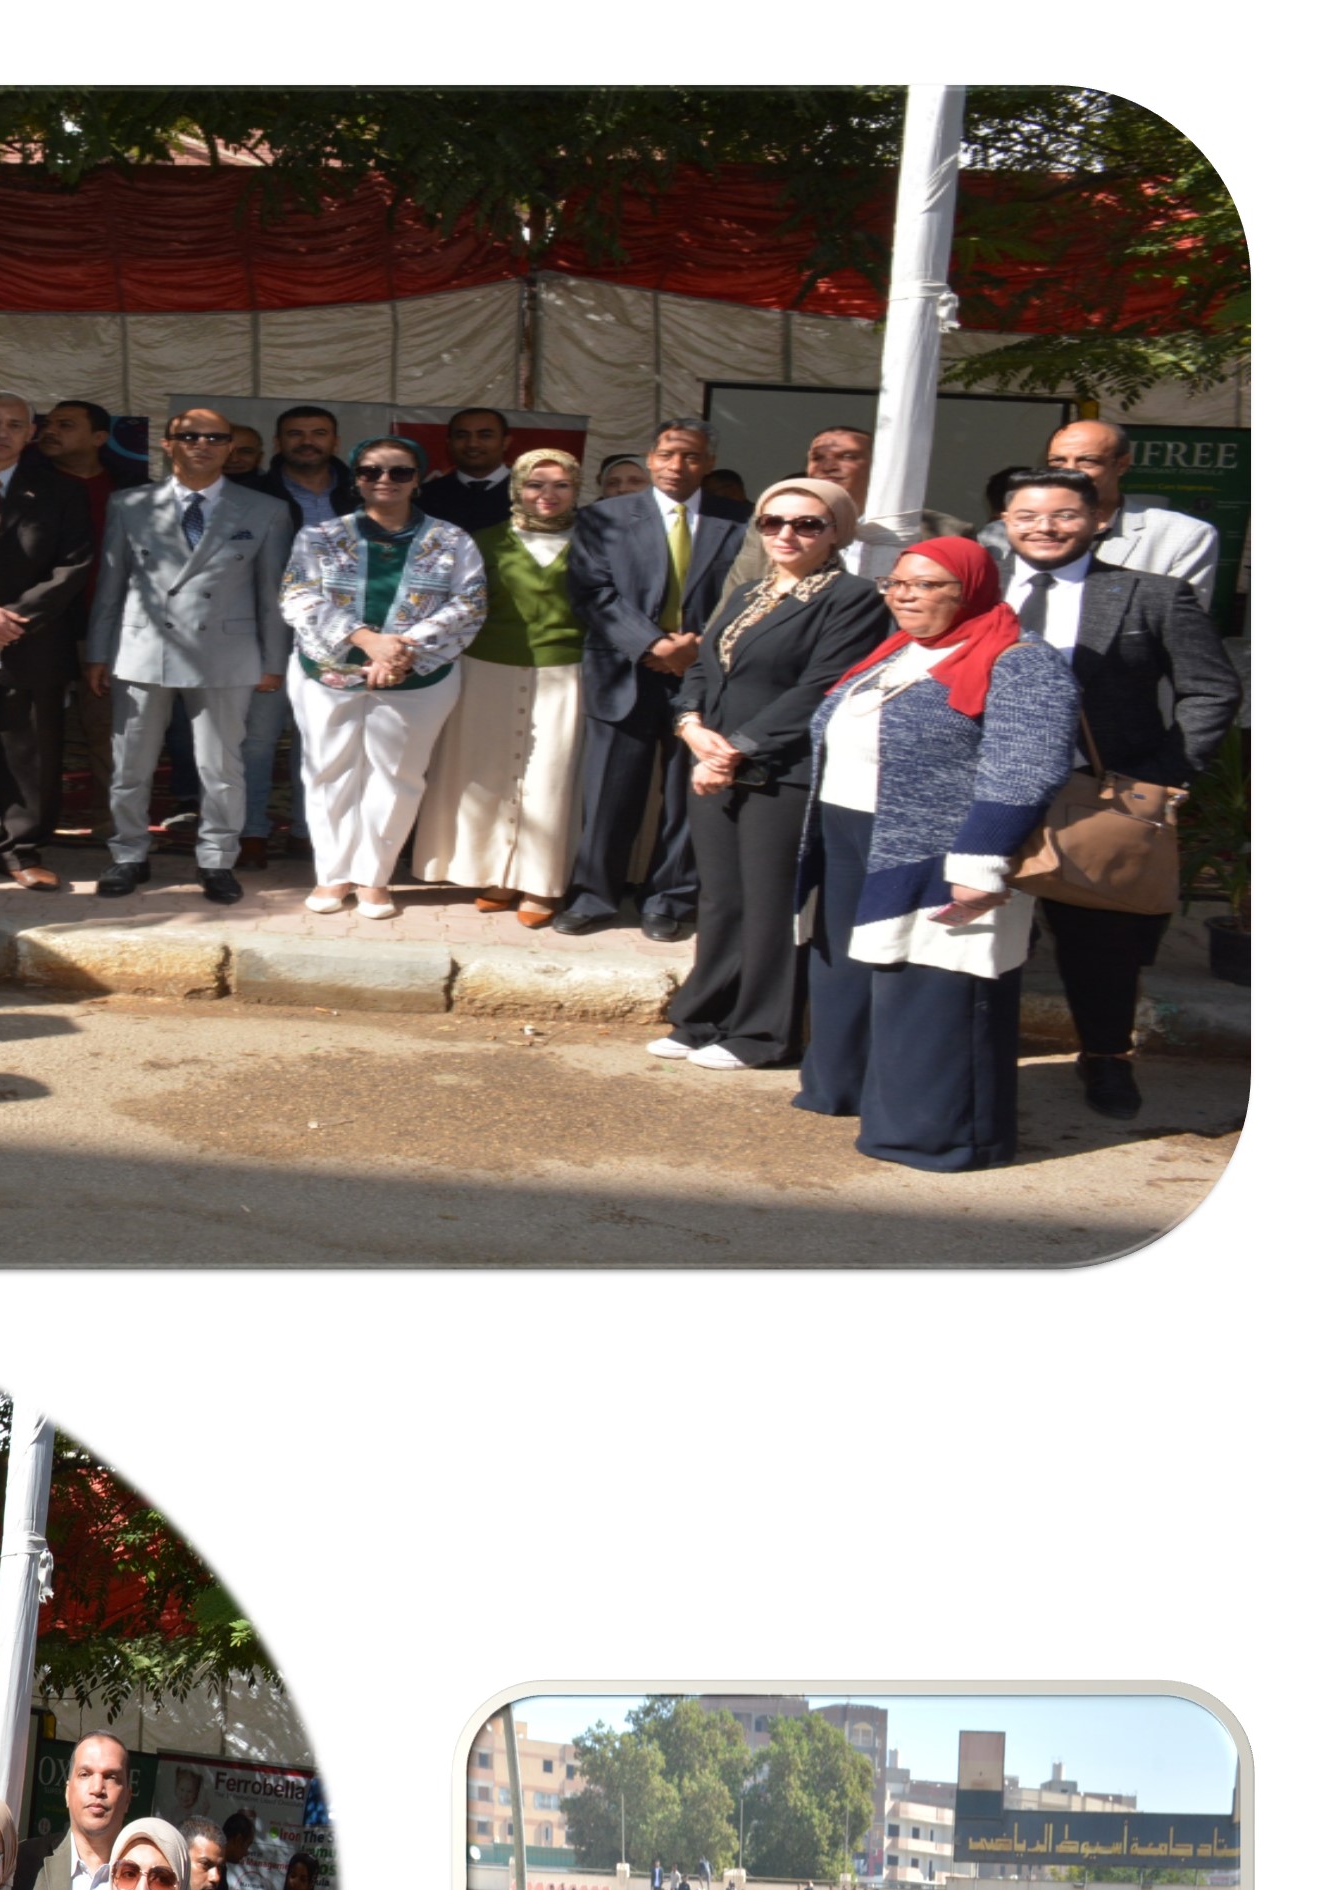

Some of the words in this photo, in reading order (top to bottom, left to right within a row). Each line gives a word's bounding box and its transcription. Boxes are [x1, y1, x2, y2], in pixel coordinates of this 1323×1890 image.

[1129, 440, 1238, 469] IFREE
[214, 1771, 306, 1800] Ferrobella
[303, 1830, 325, 1843] The
[1055, 1820, 1128, 1859] أسيوط
[1130, 1825, 1193, 1862] جامعة
